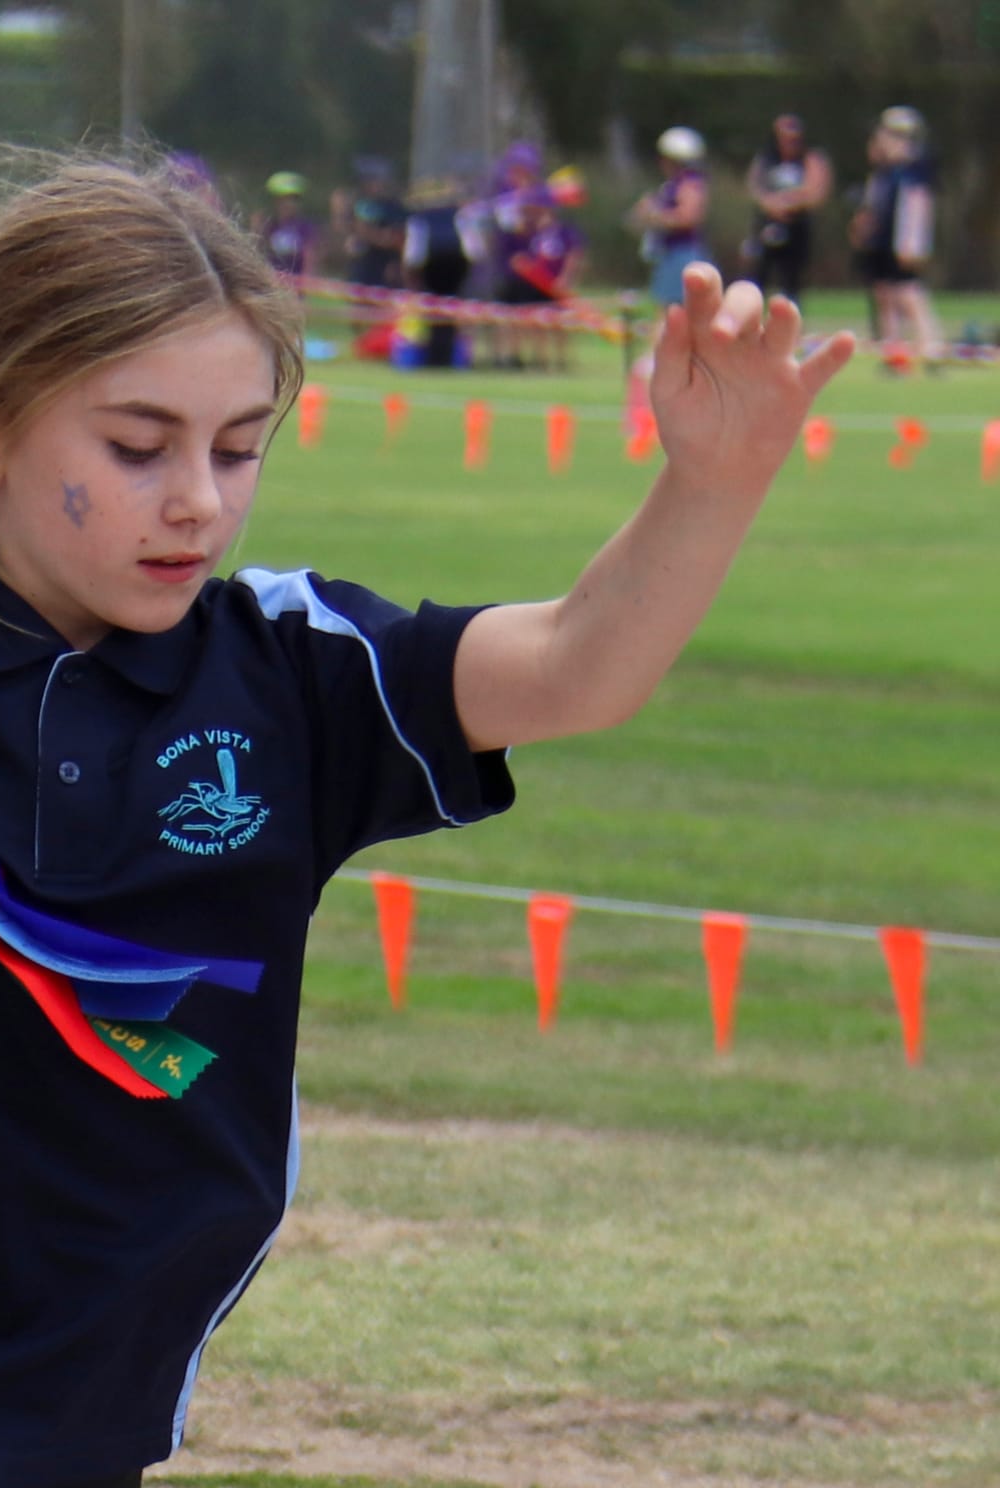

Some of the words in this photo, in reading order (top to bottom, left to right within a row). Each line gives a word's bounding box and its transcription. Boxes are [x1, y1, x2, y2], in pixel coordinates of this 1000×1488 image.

[156, 733, 201, 769] BONA
[204, 729, 251, 753] VISTA
[159, 829, 224, 856] PRIMARY
[228, 807, 271, 850] SCHOOL
